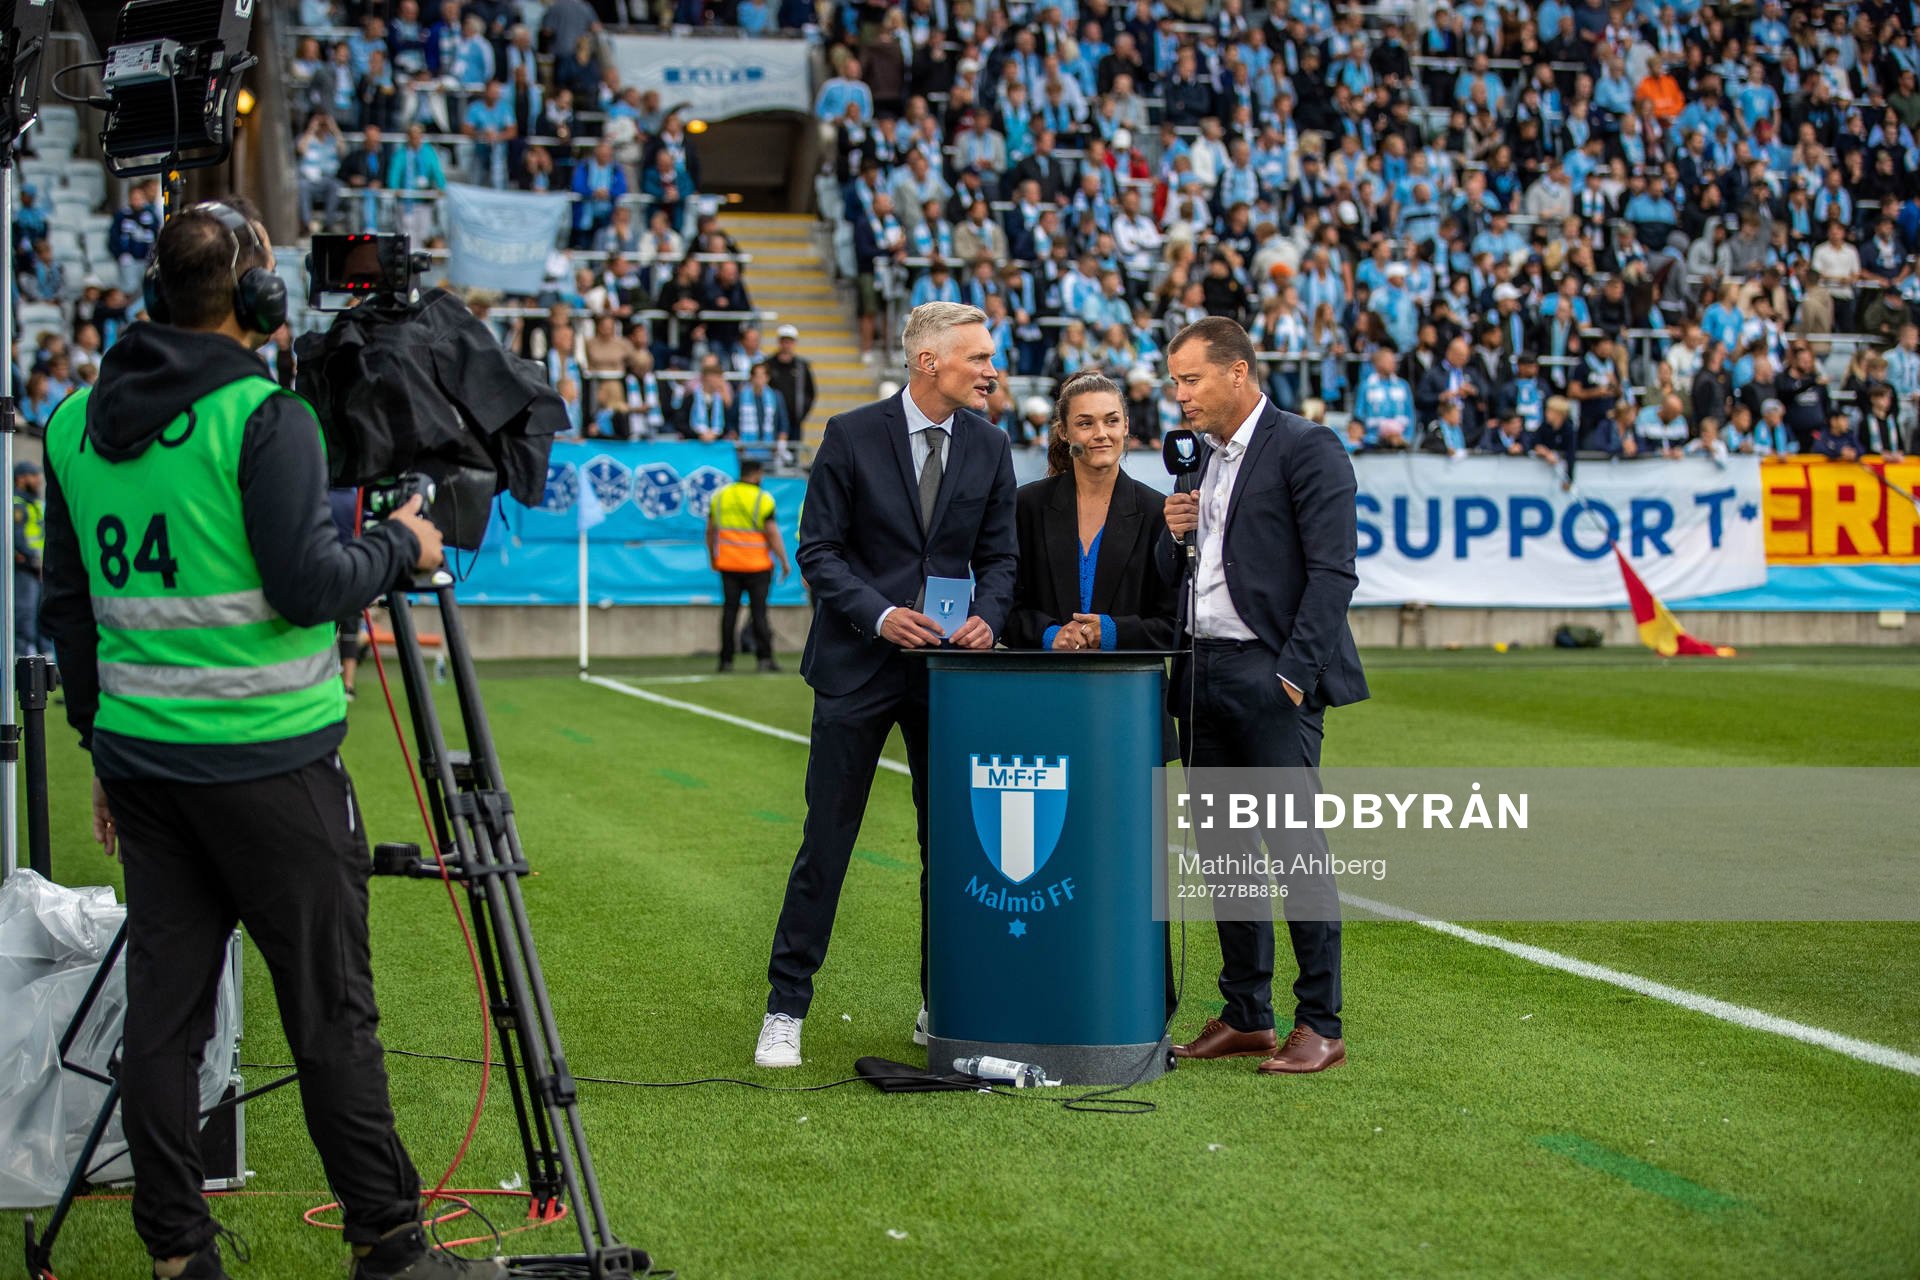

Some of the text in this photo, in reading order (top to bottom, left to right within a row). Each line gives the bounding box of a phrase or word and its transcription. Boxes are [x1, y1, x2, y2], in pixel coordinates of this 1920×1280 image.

[96, 513, 178, 589] 84
[1355, 484, 1736, 560] SUPPORT
[964, 875, 1076, 913] Malmö FF
